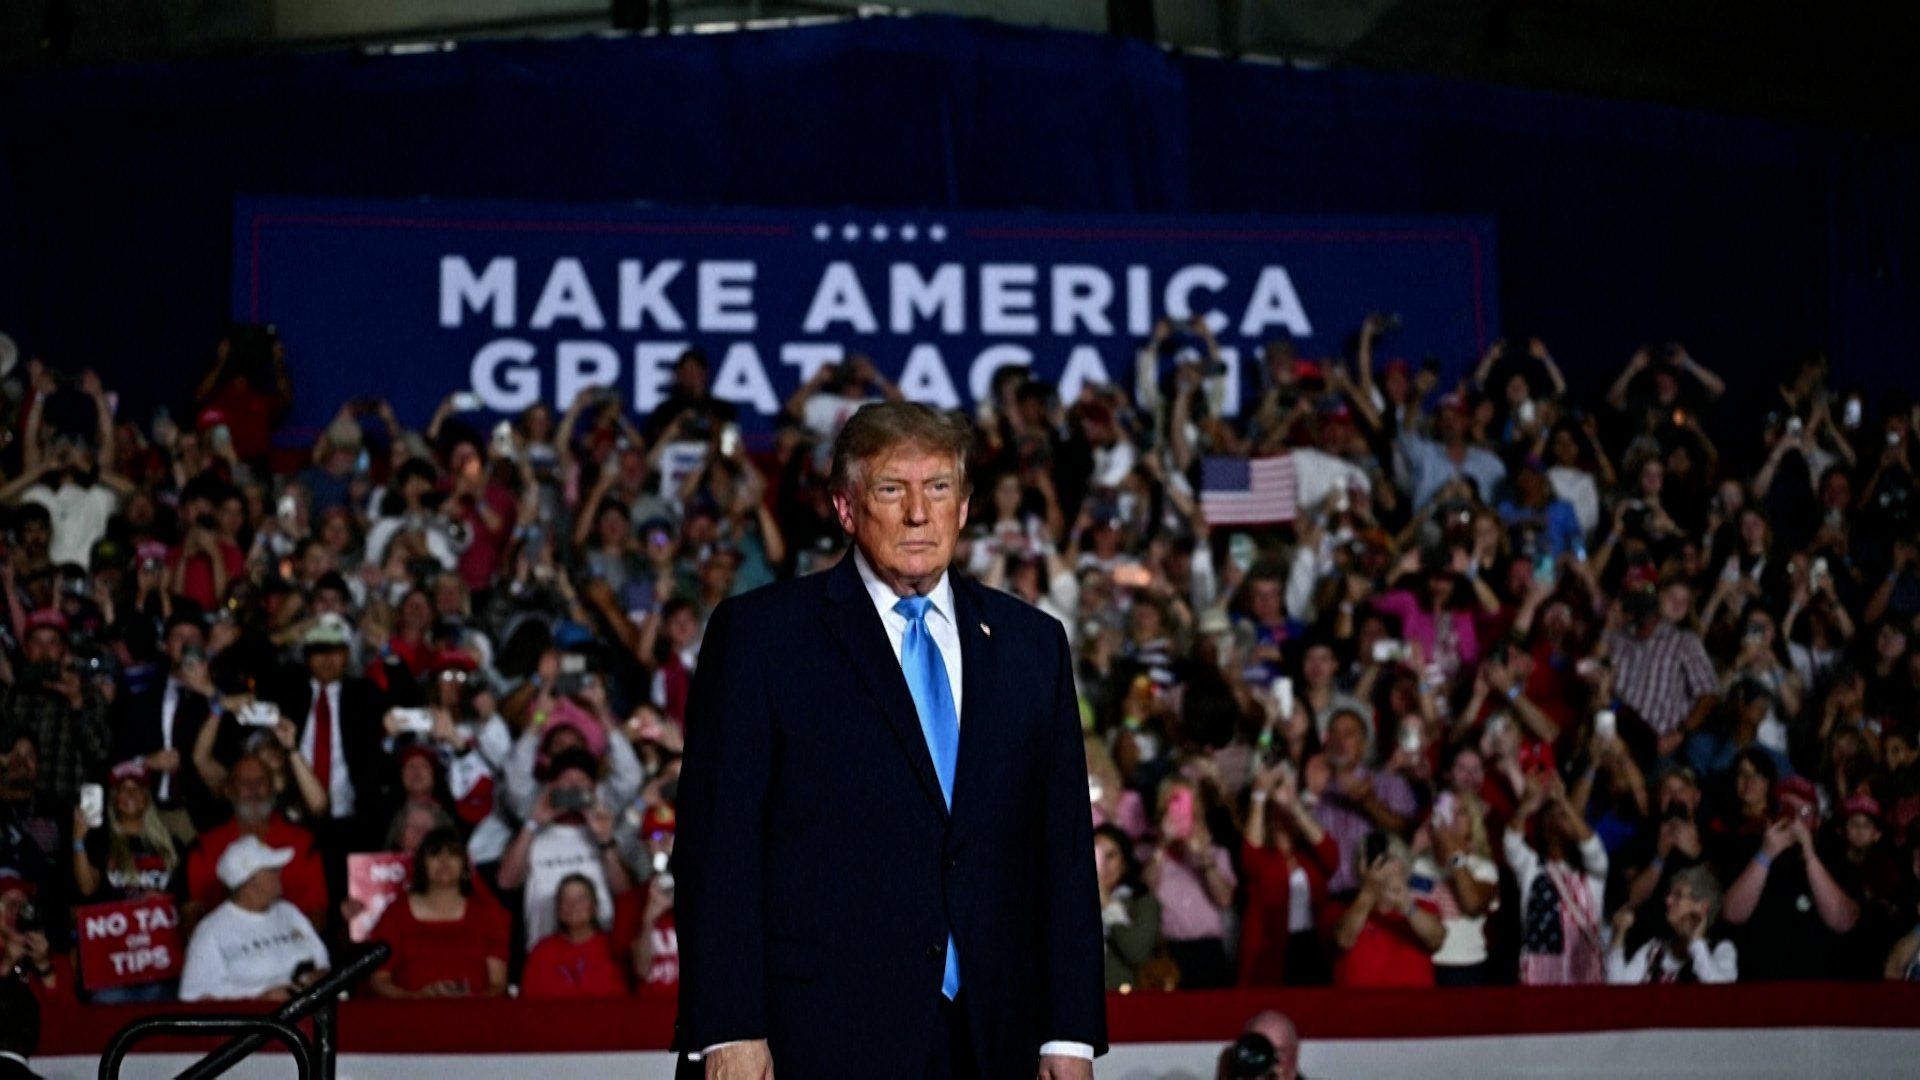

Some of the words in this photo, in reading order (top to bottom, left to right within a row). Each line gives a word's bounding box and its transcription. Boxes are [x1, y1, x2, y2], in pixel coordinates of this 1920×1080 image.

[439, 256, 756, 331] MAKE
[801, 261, 1313, 337] AMERICA
[470, 338, 844, 415] GREAT
[85, 911, 129, 941] NO
[108, 943, 172, 976] TIPS
